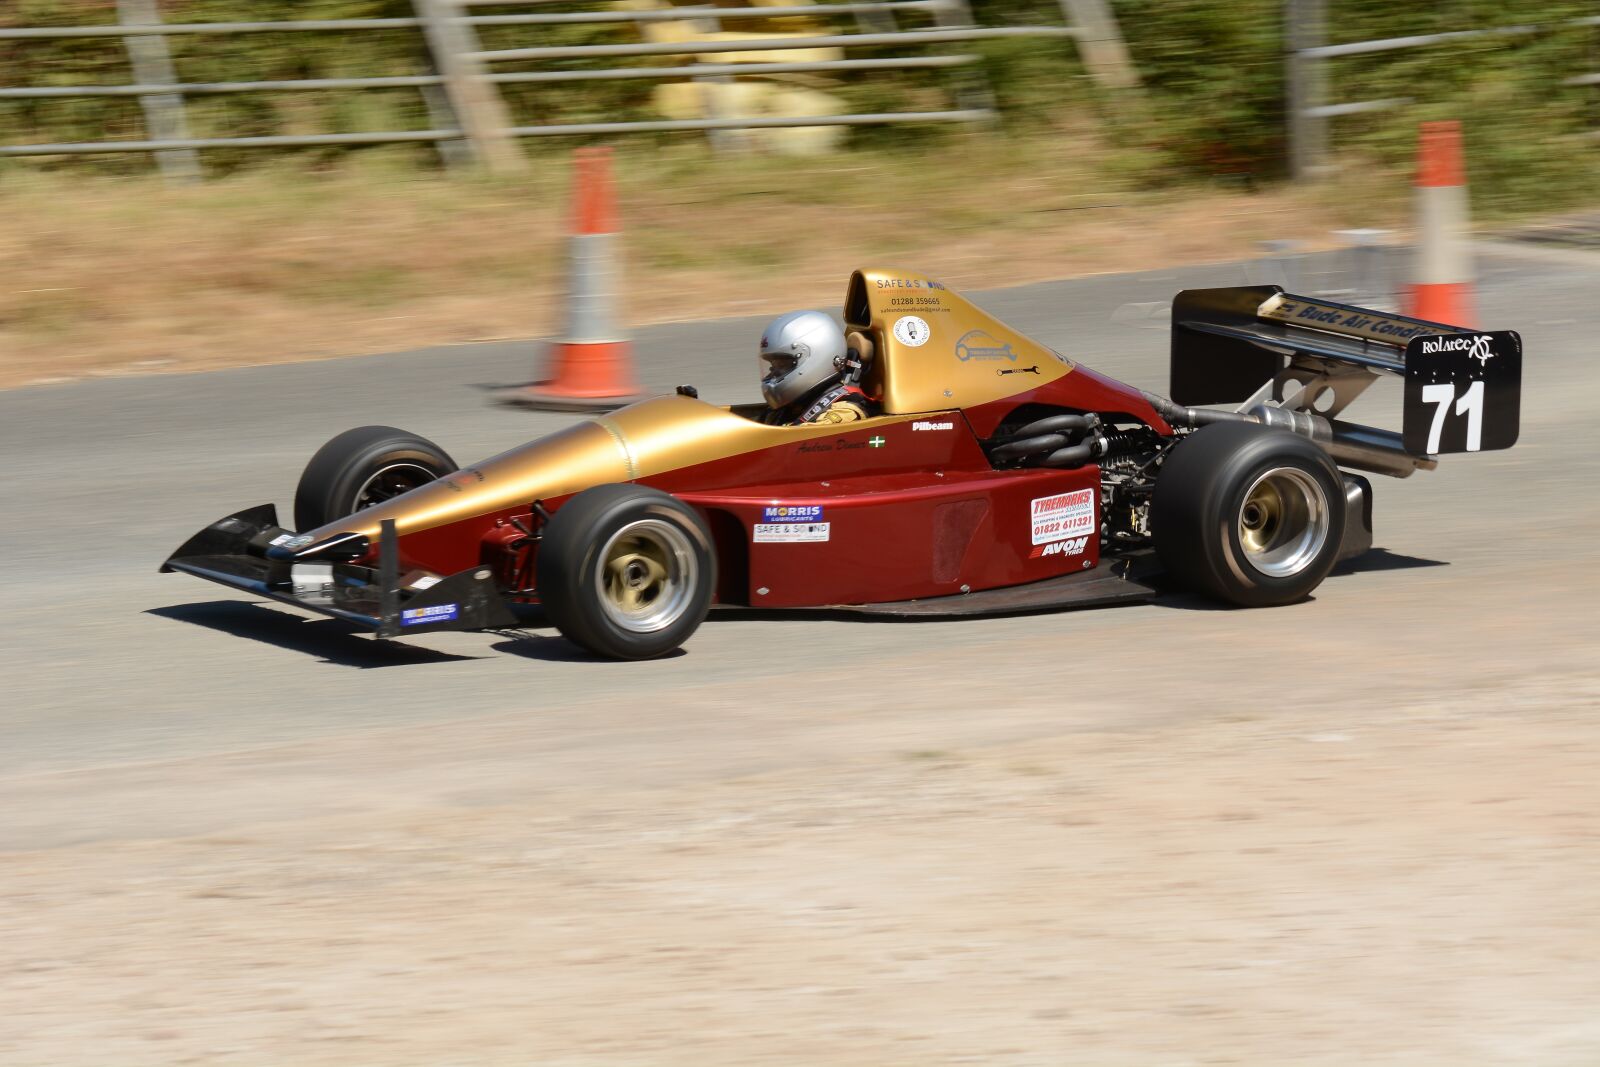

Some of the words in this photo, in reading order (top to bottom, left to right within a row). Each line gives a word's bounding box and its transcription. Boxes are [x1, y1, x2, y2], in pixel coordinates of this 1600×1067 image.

[877, 279, 903, 289] SAFE
[905, 280, 913, 288] &
[891, 298, 914, 306] 01288
[916, 297, 940, 305] 359665
[1297, 305, 1341, 325] Bude
[1341, 314, 1371, 330] Air
[1422, 380, 1485, 455] 71
[912, 421, 954, 431] Pilbeam
[1033, 490, 1092, 514] TYREMARKS
[765, 506, 820, 517] MORRIS
[757, 525, 781, 534] SAFE
[1034, 522, 1061, 536] 01822
[1062, 515, 1092, 530] 611321
[1041, 536, 1089, 557] AVON
[1065, 547, 1085, 557] TYRES
